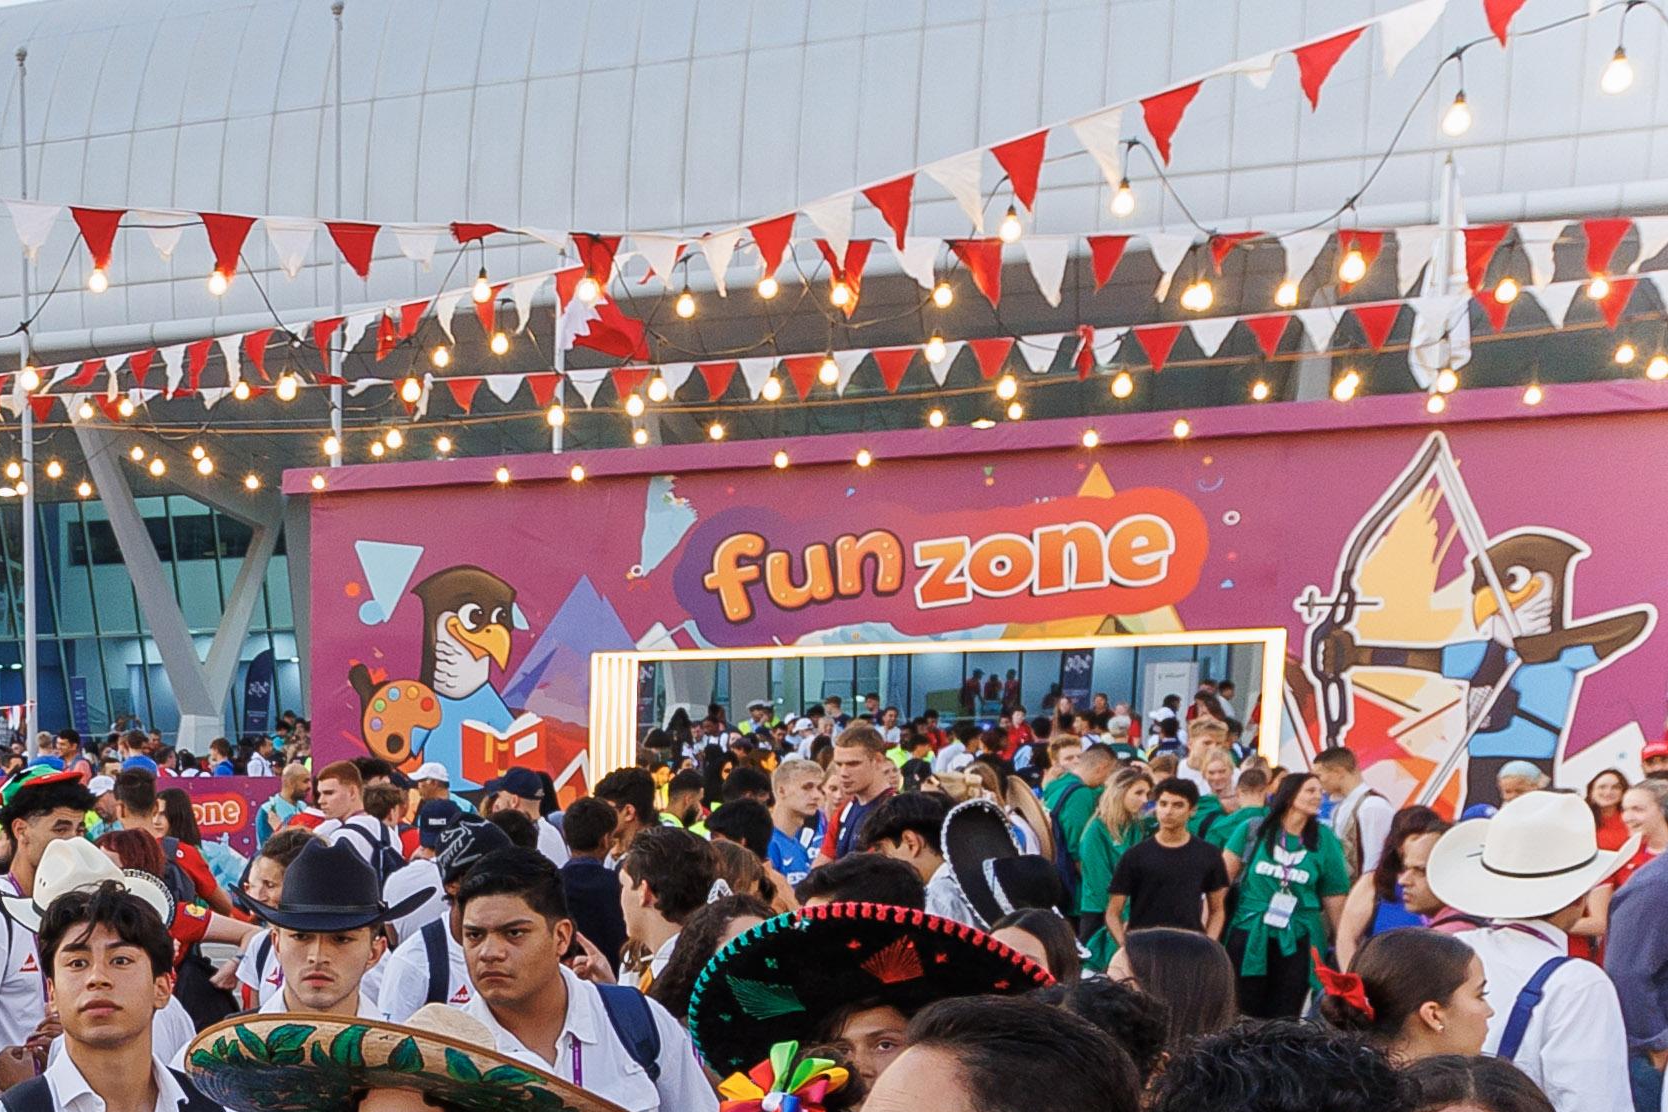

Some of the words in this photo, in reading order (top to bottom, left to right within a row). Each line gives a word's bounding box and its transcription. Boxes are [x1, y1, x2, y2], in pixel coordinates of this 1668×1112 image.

[704, 529, 905, 622] fun
[913, 513, 1176, 610] zone
[192, 800, 241, 826] one
